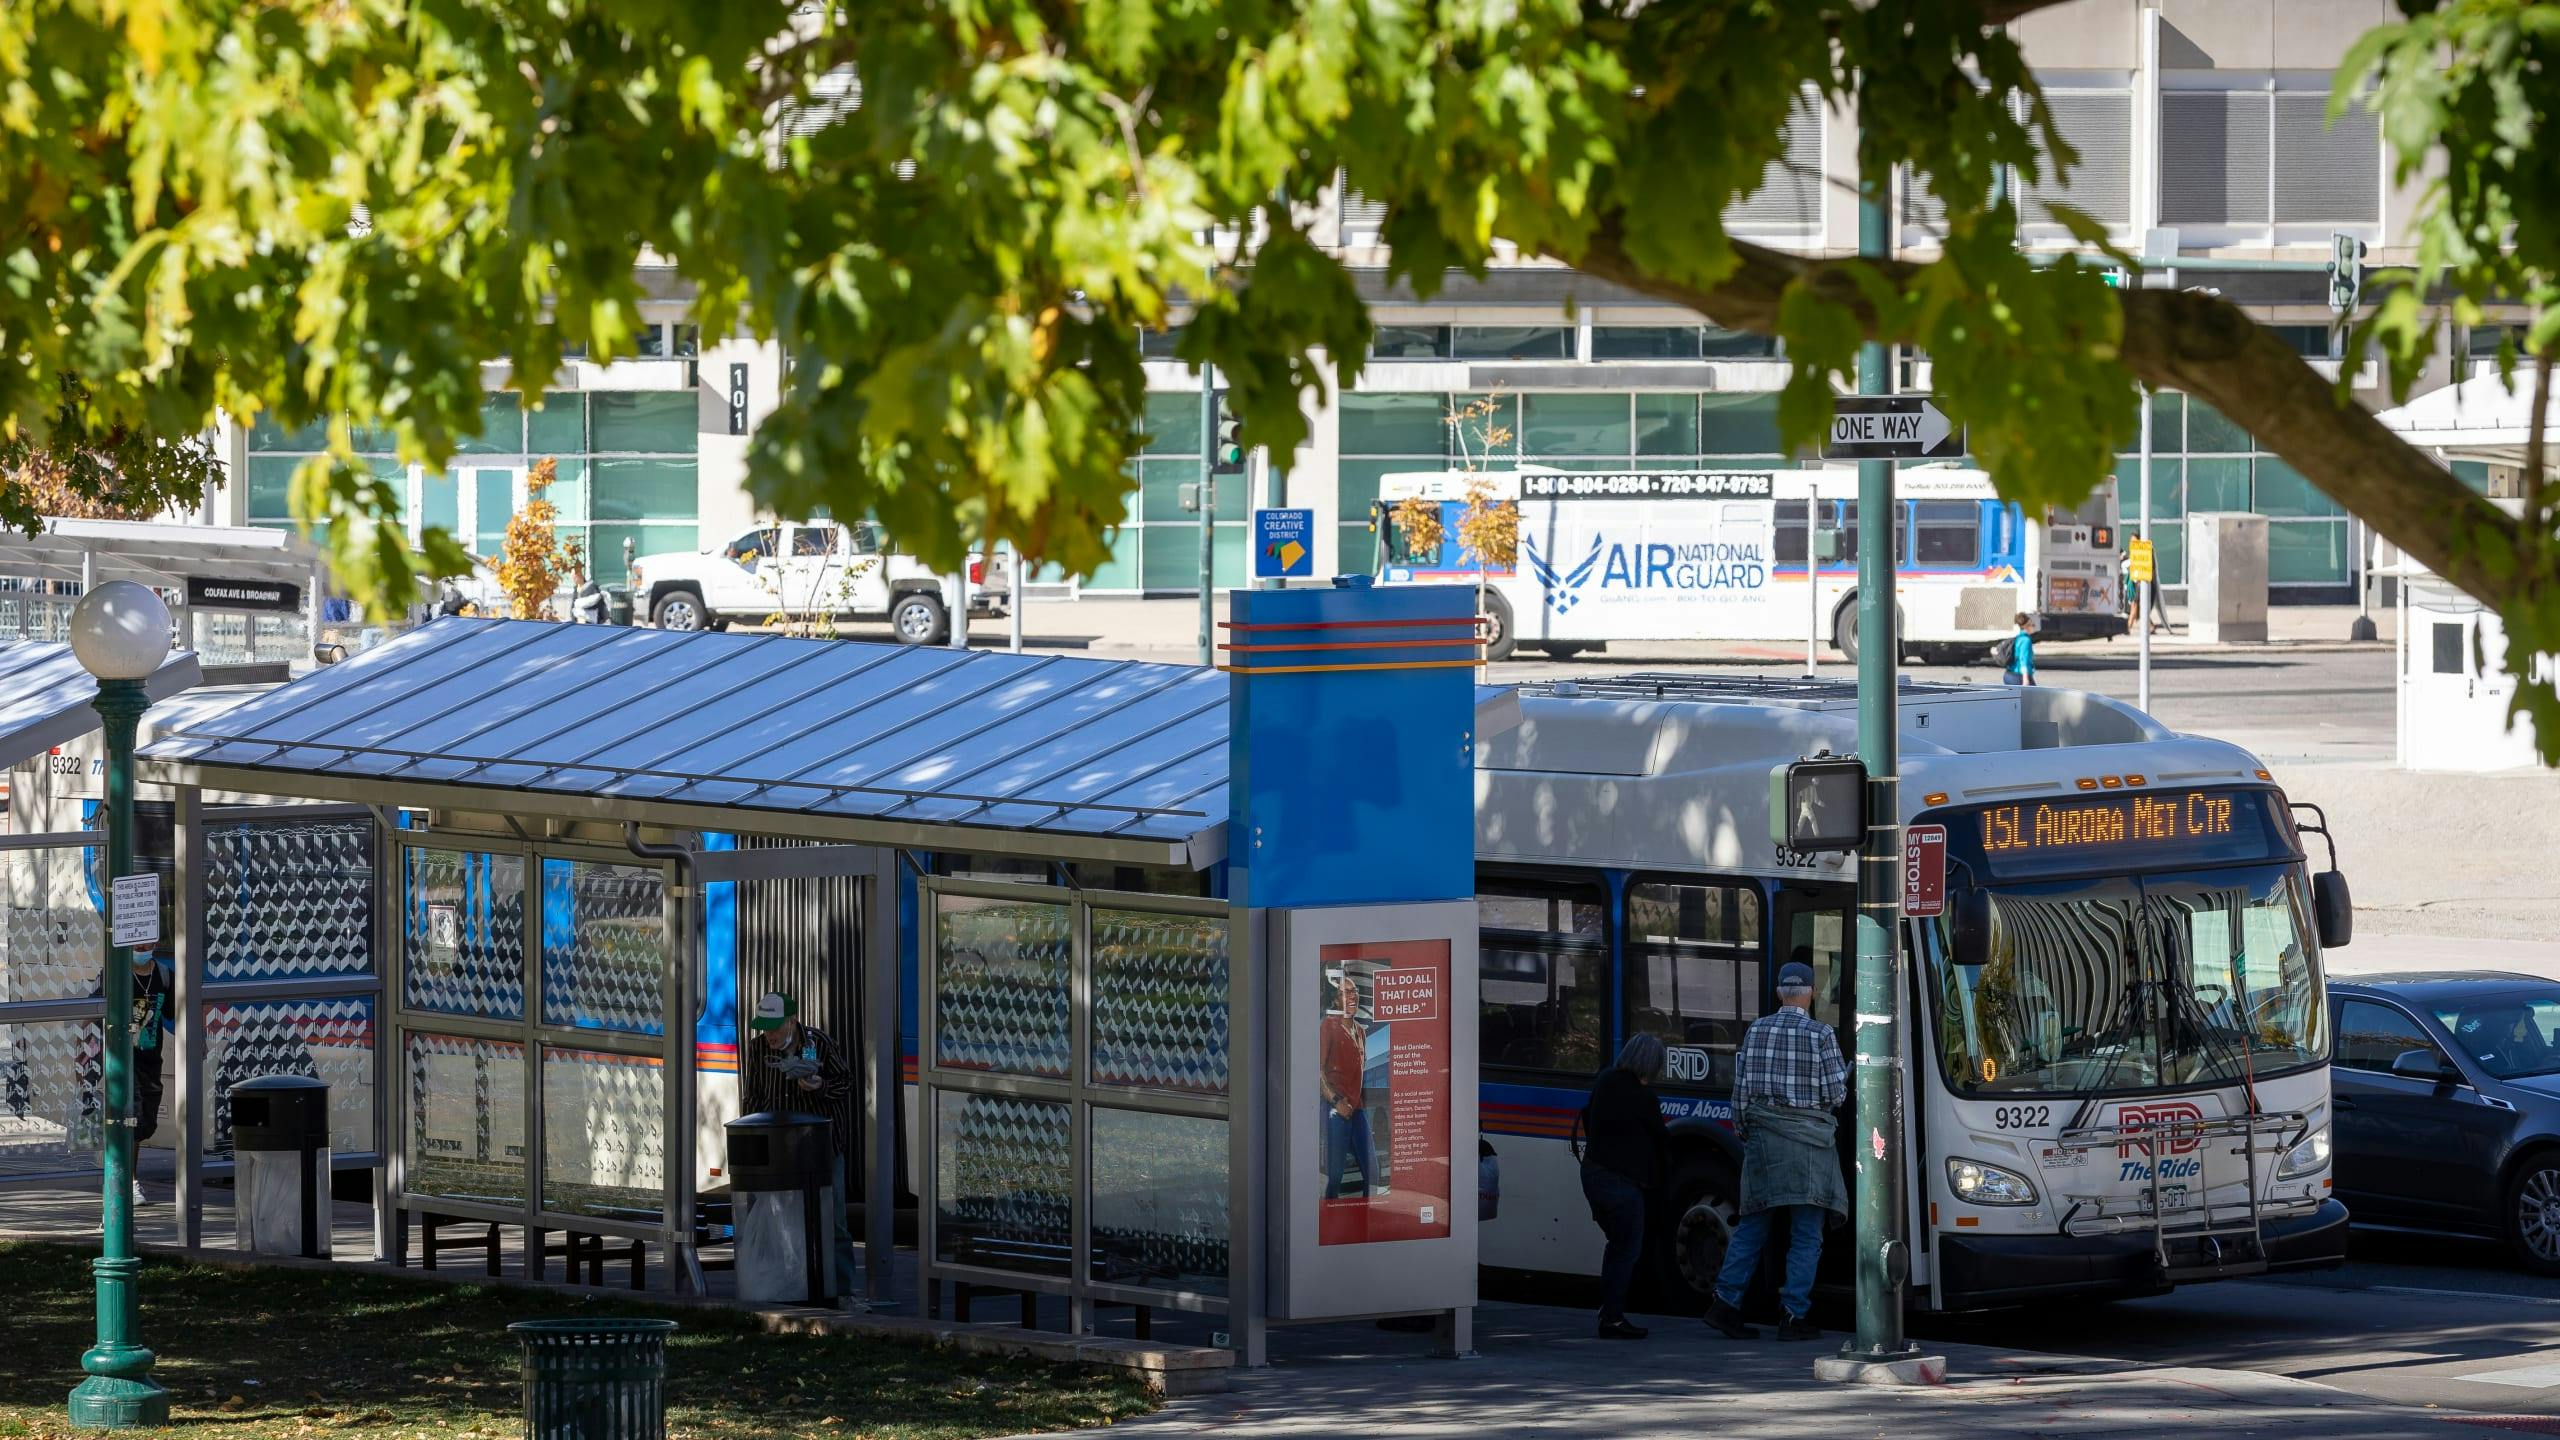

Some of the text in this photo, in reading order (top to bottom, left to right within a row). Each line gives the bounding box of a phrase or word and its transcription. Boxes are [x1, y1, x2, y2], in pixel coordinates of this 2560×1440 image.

[734, 368, 745, 429] 101
[1837, 415, 1922, 440] ONE WAY
[1266, 511, 1304, 520] COLORADO
[1264, 520, 1305, 530] CREATIVE
[1269, 531, 1299, 539] DISTRICT
[1677, 543, 1764, 562] NATIONAL
[1600, 543, 1676, 589] AIR
[1677, 564, 1764, 589] GUARD
[204, 587, 280, 601] COLFAX AVE & BROADWAY
[52, 757, 80, 775] 9322
[1907, 833, 1921, 893] MY STOP
[1399, 975, 1412, 985] DO
[1415, 974, 1432, 984] ALL
[1381, 990, 1405, 1001] THAT
[1412, 988, 1433, 999] CAN
[1381, 1005, 1393, 1015] TO
[1409, 1068, 1428, 1076] People
[1666, 1046, 1710, 1081] RTD
[1995, 1105, 2050, 1130] 9322
[2118, 1101, 2204, 1159] RTD
